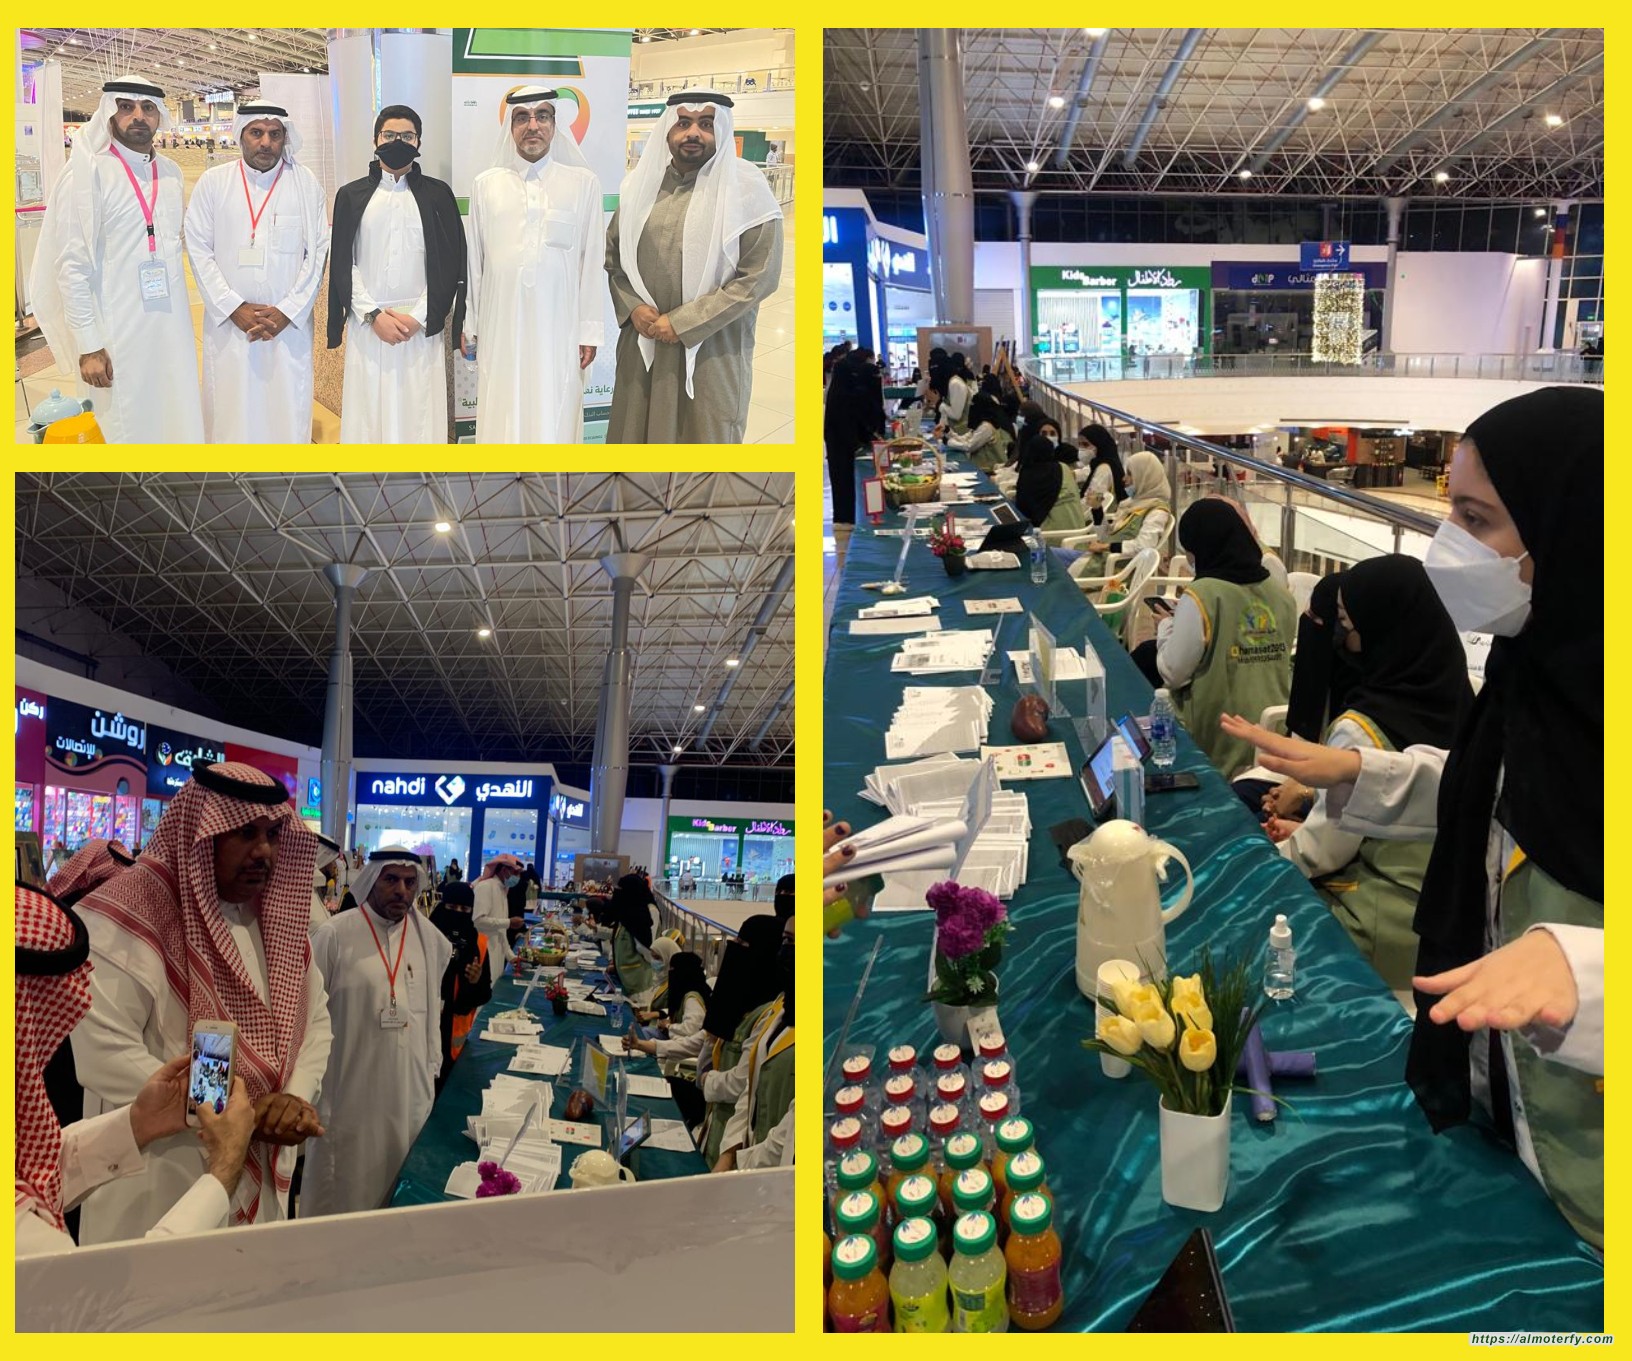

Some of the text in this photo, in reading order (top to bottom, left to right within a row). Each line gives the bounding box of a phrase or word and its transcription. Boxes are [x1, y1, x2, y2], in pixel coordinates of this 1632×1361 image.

[19, 697, 44, 720] ركن
[90, 711, 145, 750] روشن
[372, 777, 426, 796] nahdi
[475, 780, 533, 802] النهدي
